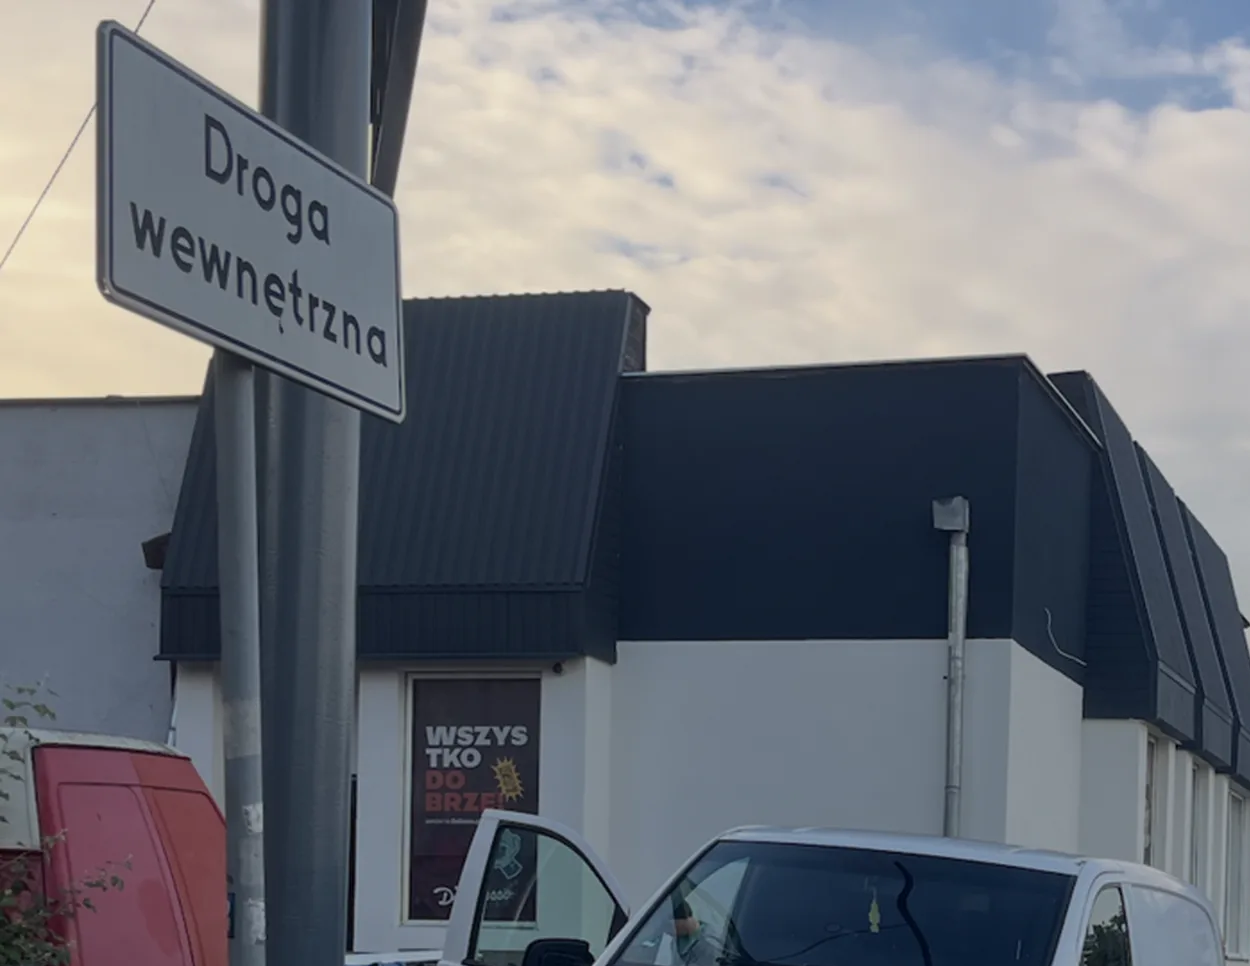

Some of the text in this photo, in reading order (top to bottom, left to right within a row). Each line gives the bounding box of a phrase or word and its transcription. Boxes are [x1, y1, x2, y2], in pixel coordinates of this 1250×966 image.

[203, 112, 331, 246] Droga
[129, 201, 388, 368] wewnętrzna
[425, 725, 528, 747] WSZYS
[425, 748, 482, 769] TKO
[425, 770, 467, 791] DO
